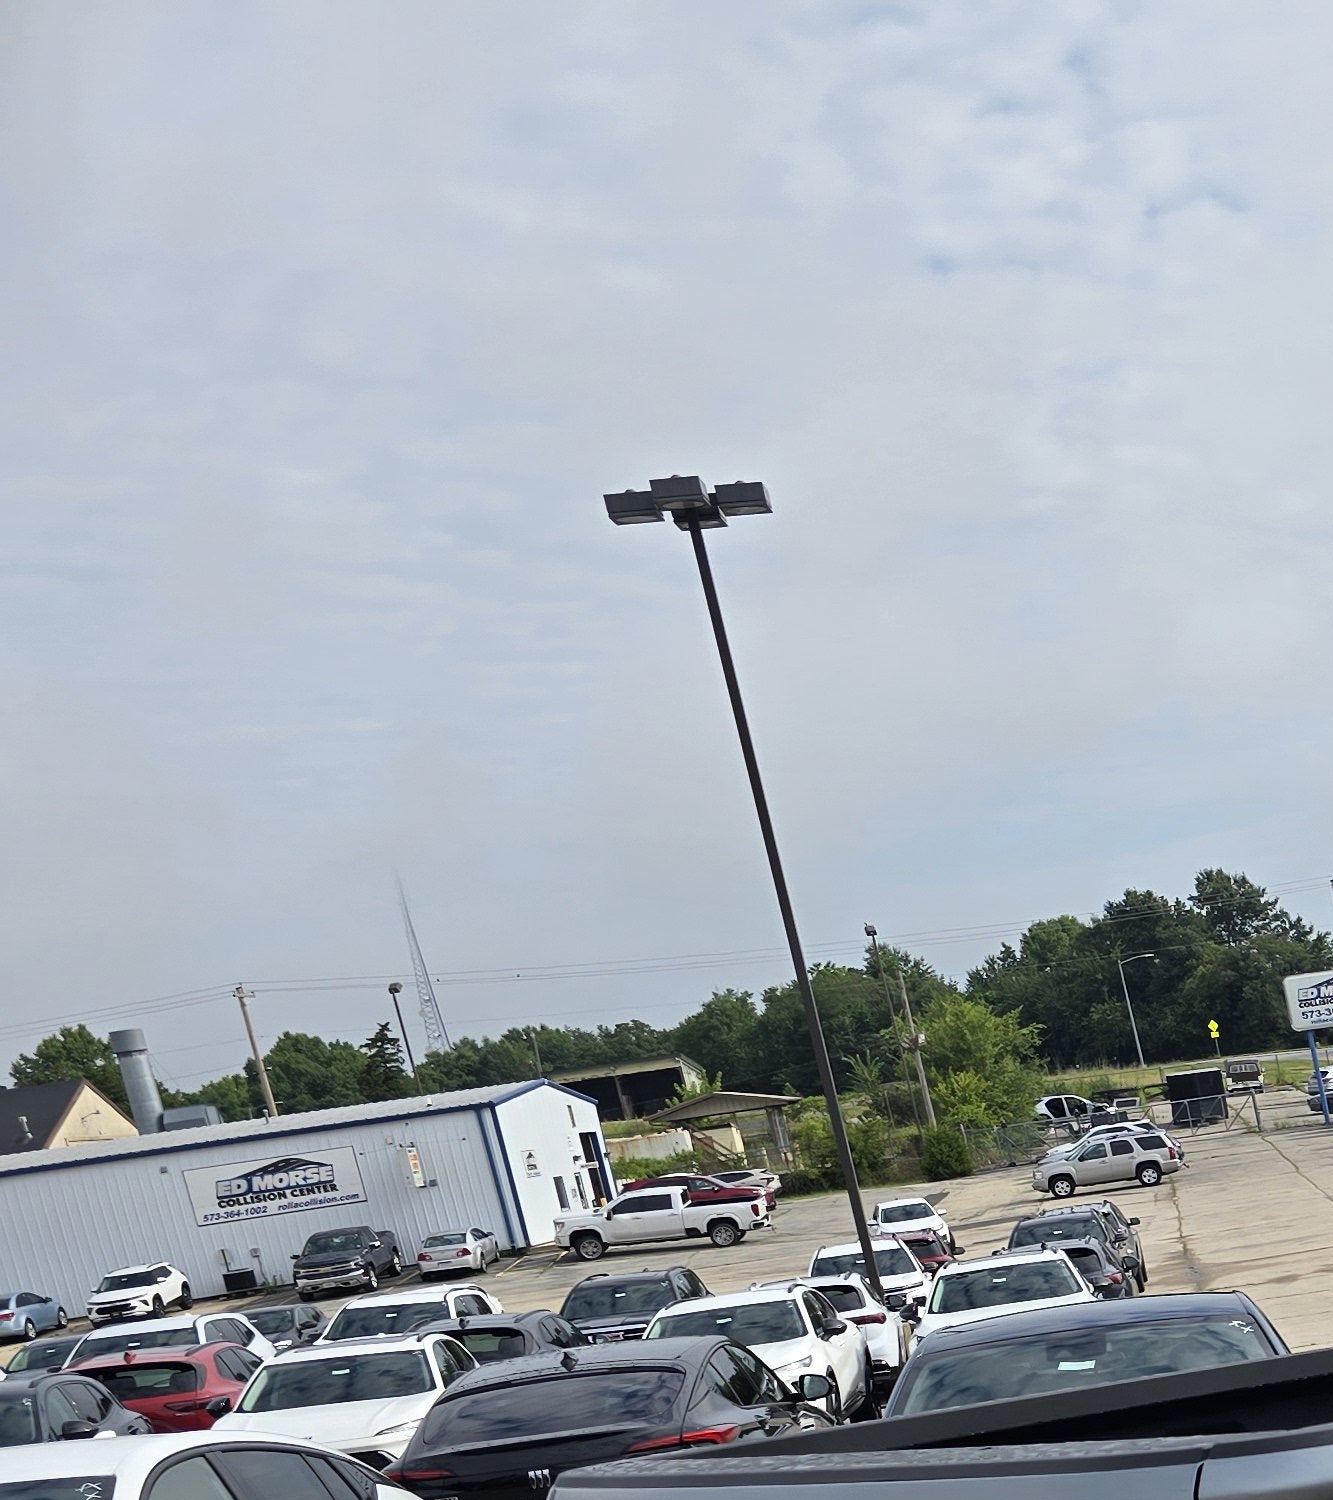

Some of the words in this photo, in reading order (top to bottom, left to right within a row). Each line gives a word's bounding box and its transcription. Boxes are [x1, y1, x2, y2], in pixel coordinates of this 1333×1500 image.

[1298, 987, 1318, 1000] ED
[217, 1177, 249, 1197] ED
[252, 1165, 333, 1195] MORSE
[203, 1205, 268, 1222] 573-364-1002
[278, 1193, 360, 1211] rollacollision.com
[217, 1190, 287, 1209] COLLISION
[290, 1183, 339, 1198] CENTER
